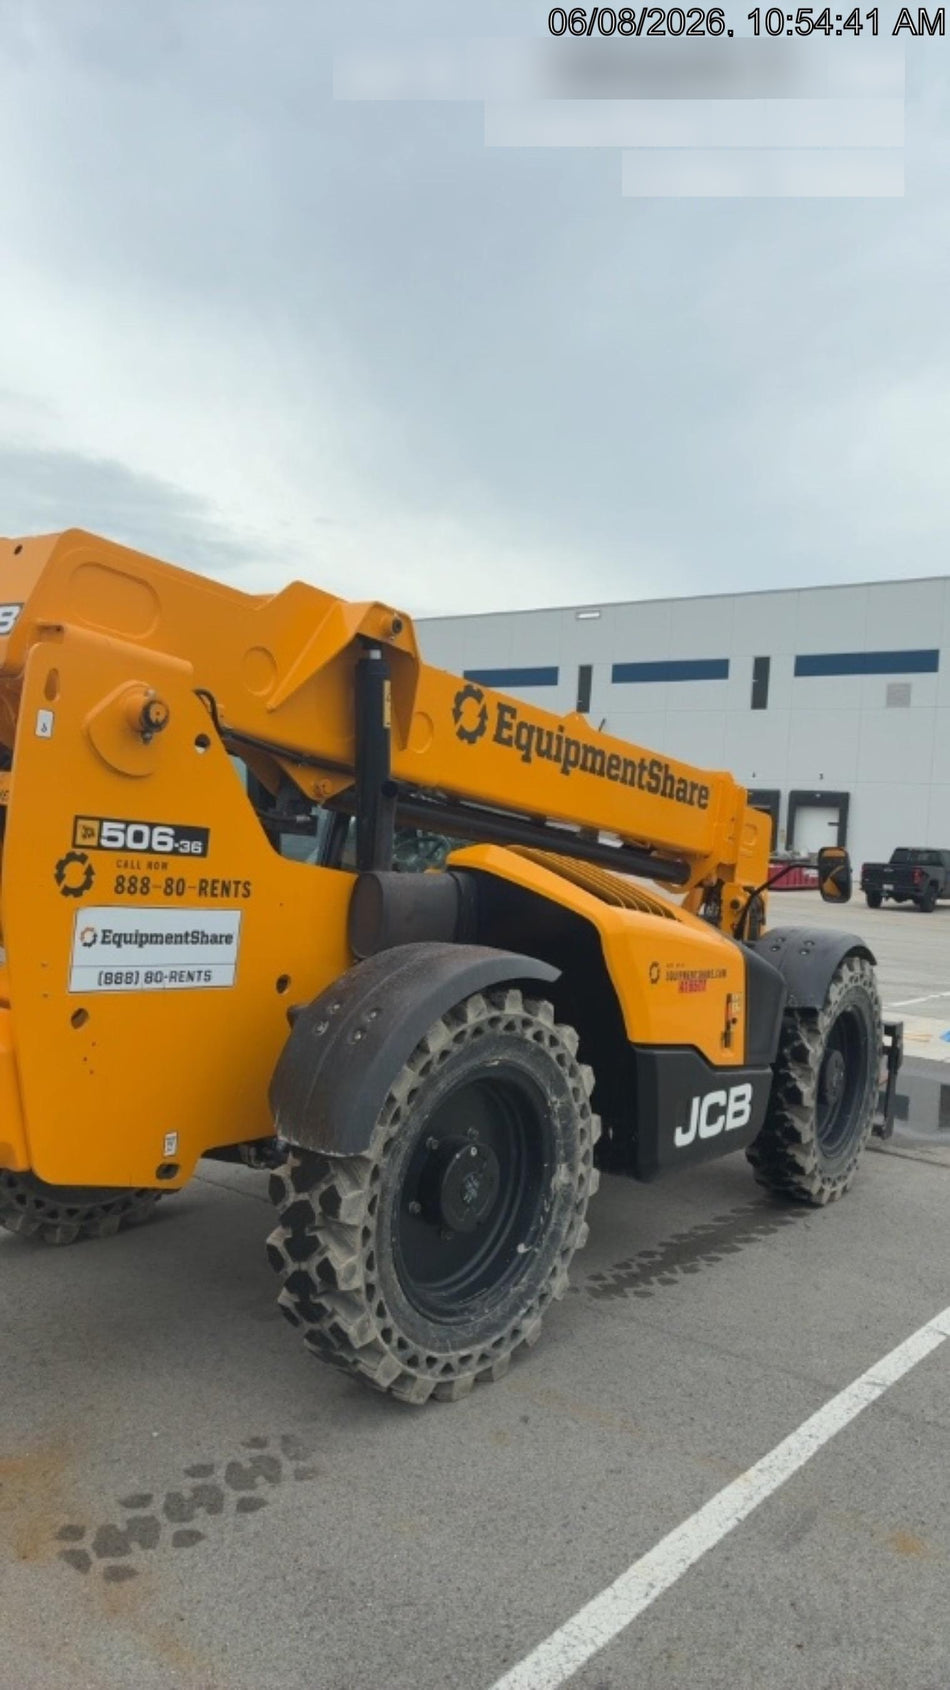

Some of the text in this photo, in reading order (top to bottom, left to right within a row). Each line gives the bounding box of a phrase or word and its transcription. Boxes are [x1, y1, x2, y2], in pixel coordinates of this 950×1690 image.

[492, 701, 710, 810] EquipmentShare
[116, 859, 169, 871] CALL NOW
[114, 875, 252, 898] 888-80-RENTS
[100, 929, 234, 949] EquipmentShare
[97, 970, 213, 986] (888) 80-RENTS
[674, 1082, 753, 1148] JCB
